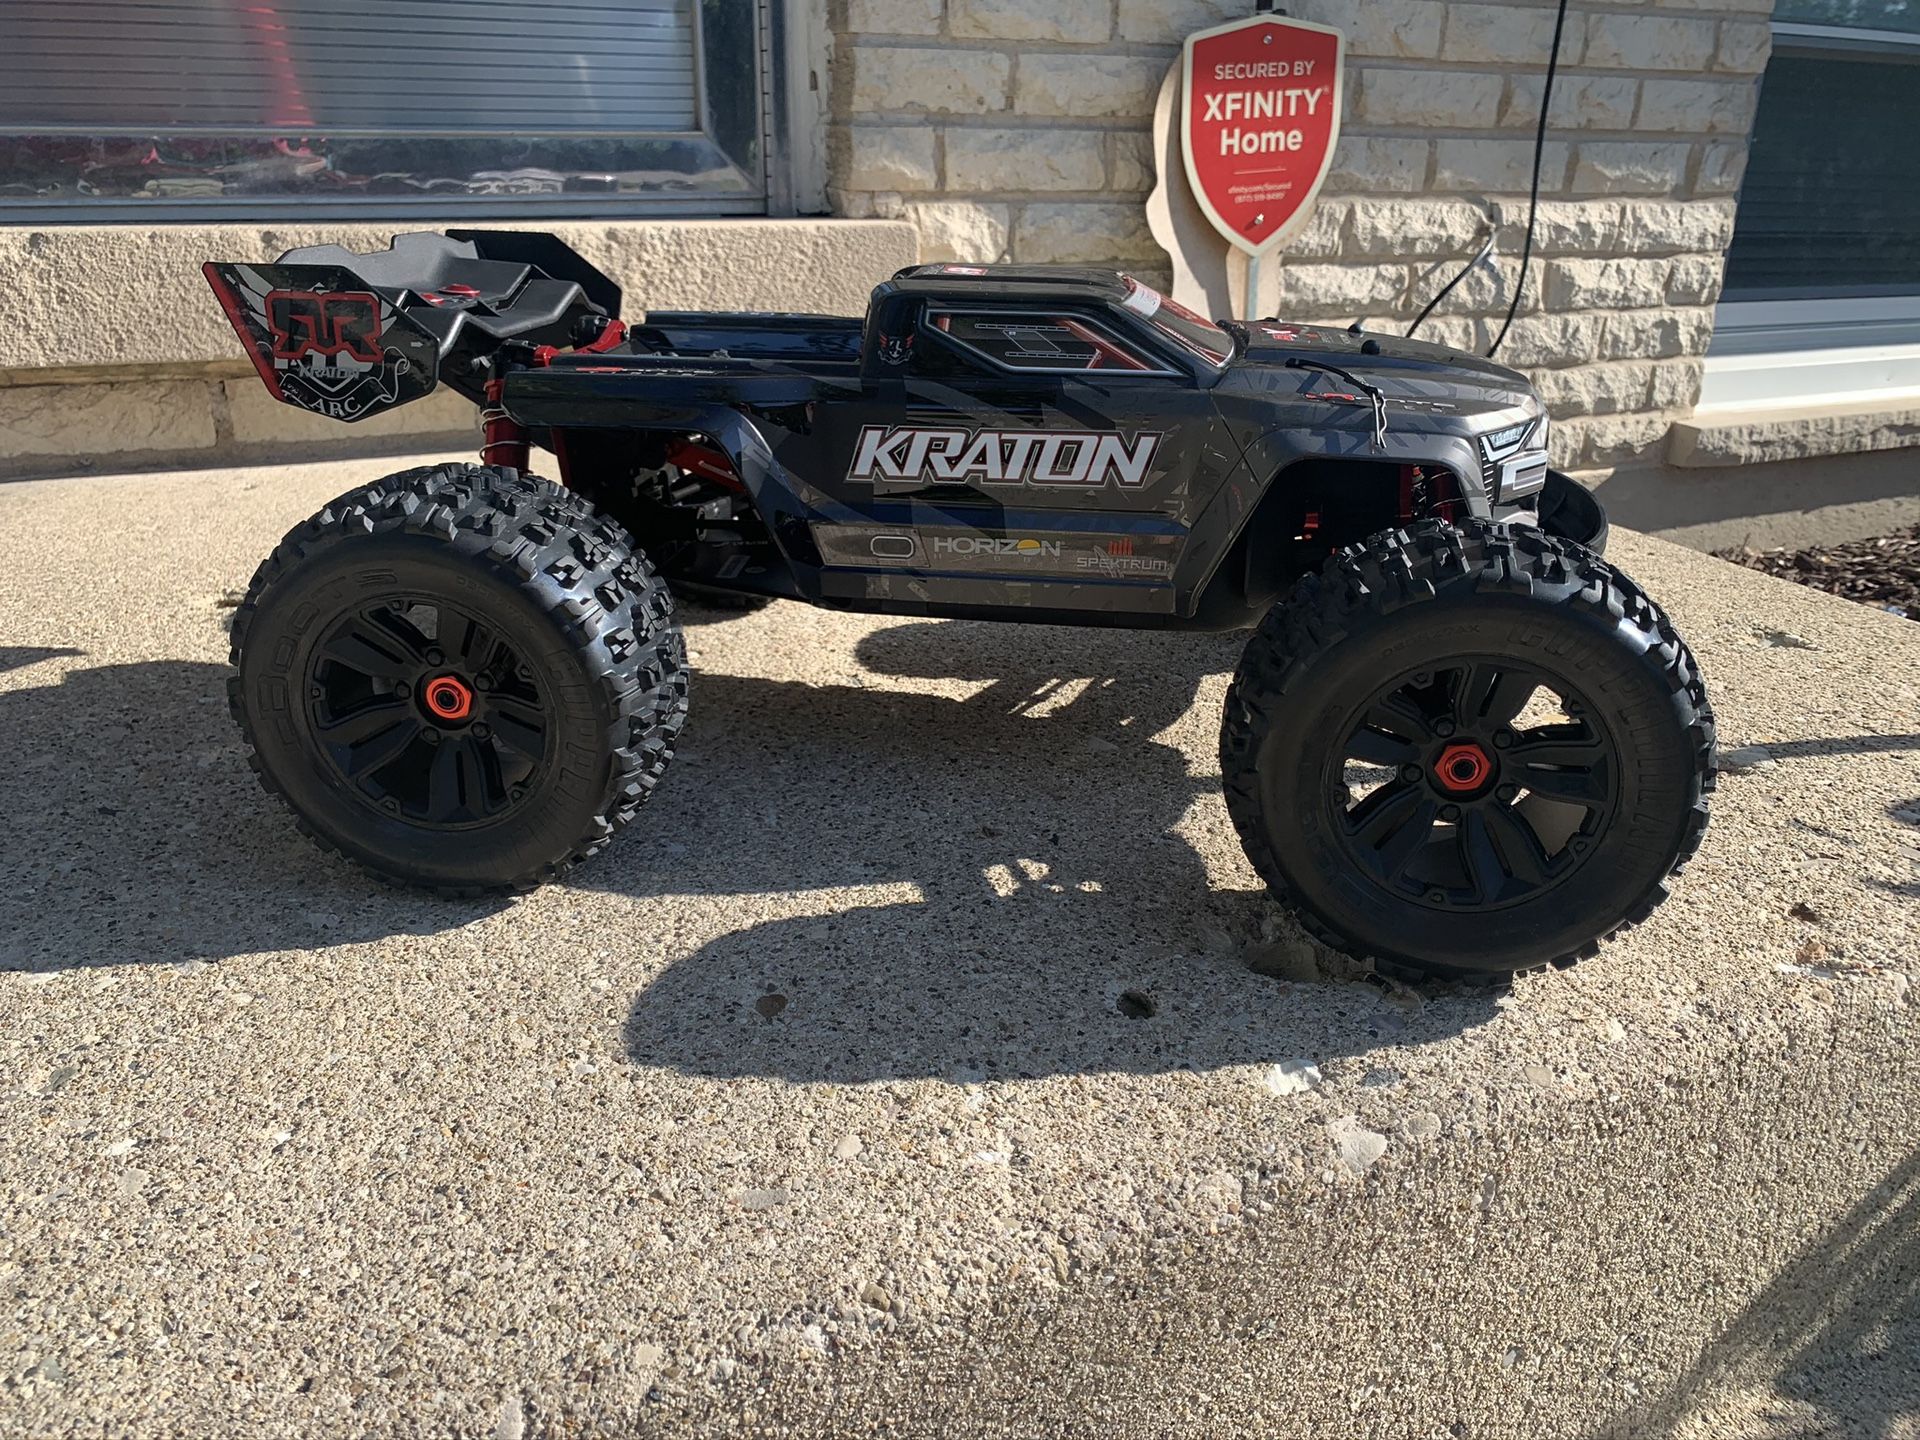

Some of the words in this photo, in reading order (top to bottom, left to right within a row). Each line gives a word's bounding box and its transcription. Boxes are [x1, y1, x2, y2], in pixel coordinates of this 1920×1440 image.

[1214, 62, 1290, 80] SECURED
[1293, 60, 1314, 76] BY
[1203, 88, 1322, 122] XFINITY
[1220, 128, 1303, 156] Home
[847, 425, 1163, 488] KRATON
[934, 537, 1061, 557] HORIZON
[1076, 556, 1168, 572] SPEKTRUM
